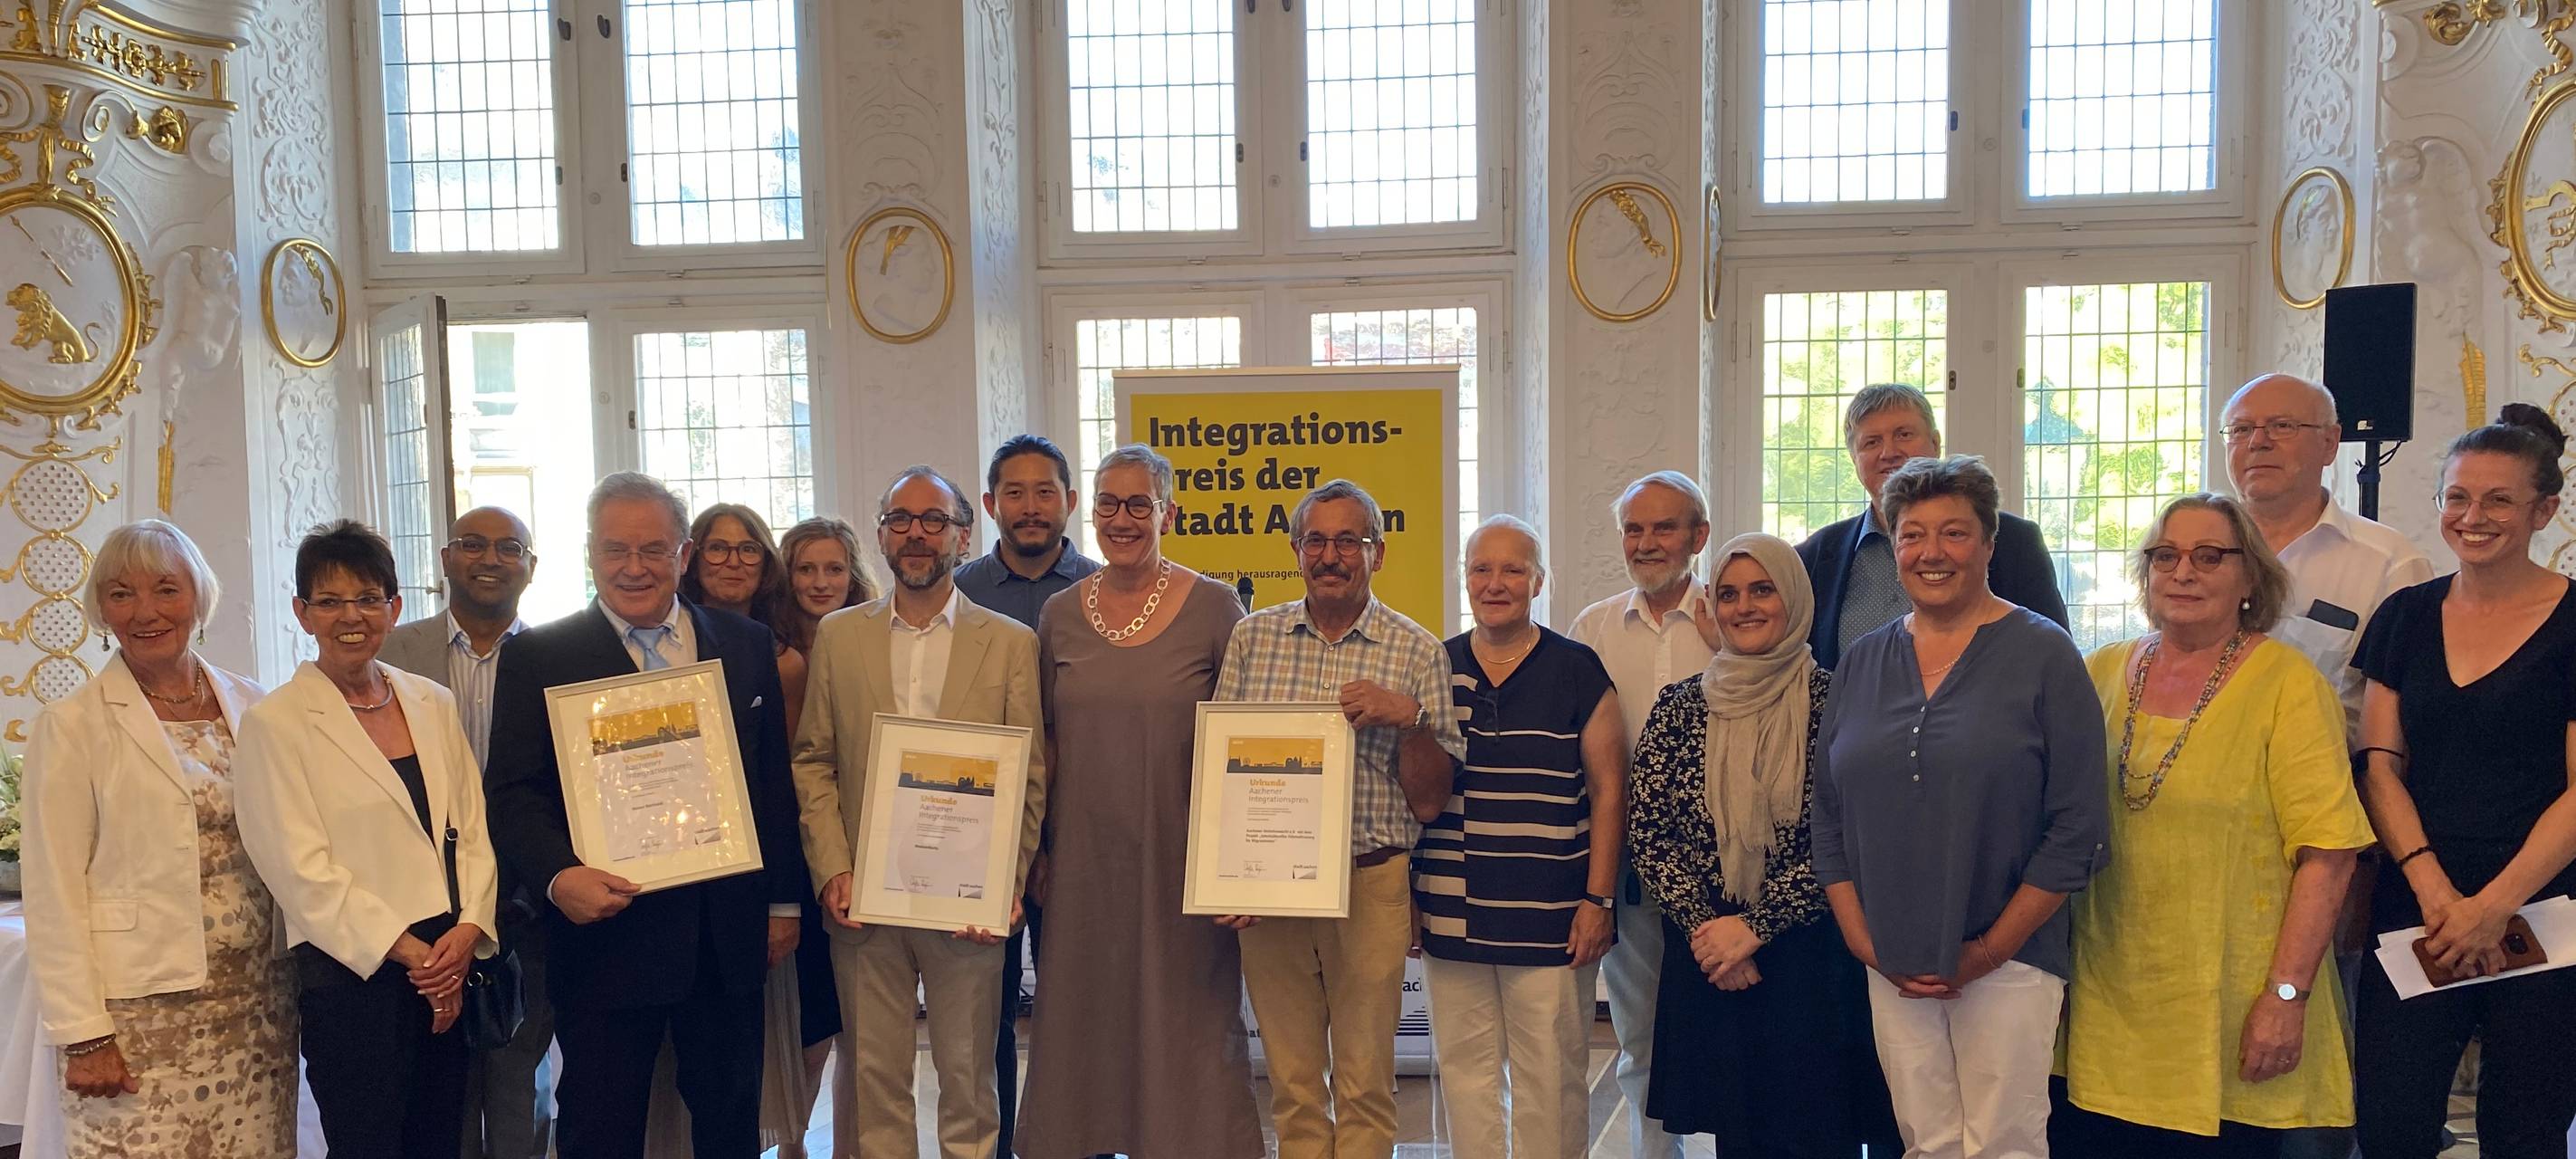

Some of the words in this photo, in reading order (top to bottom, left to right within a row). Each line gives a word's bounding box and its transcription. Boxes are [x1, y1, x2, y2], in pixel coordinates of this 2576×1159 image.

[1150, 412, 1402, 455] Integrations-
[1173, 458, 1245, 492] reis
[1256, 457, 1321, 490] der
[1174, 503, 1254, 535] tadt
